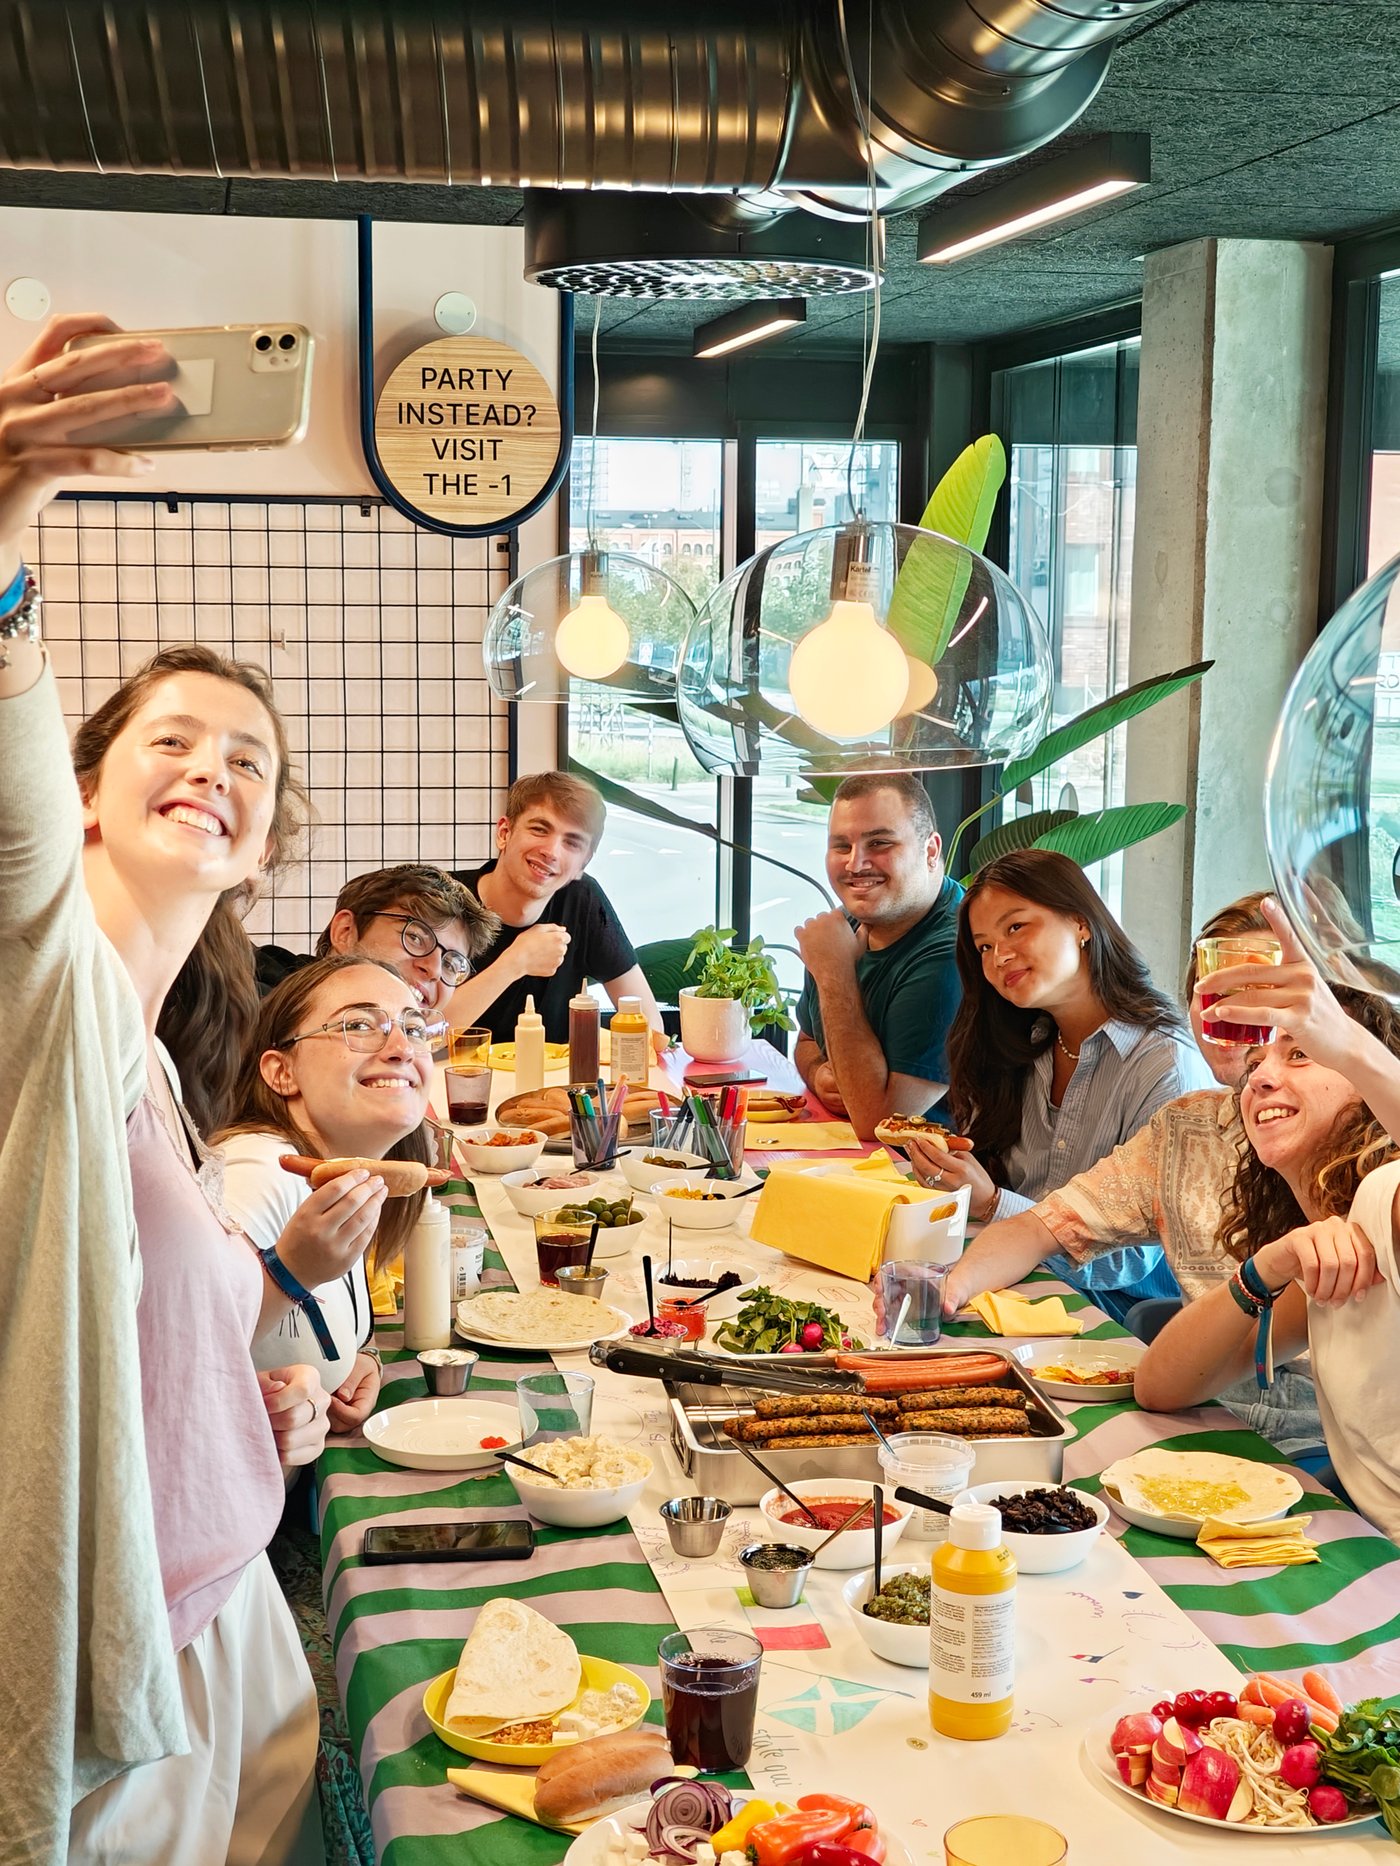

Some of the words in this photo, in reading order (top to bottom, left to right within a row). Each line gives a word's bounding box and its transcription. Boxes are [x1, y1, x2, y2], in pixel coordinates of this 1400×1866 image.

[421, 367, 513, 391] PARTY
[398, 402, 537, 426] INSTEAD?
[431, 438, 504, 461] VISIT
[423, 473, 478, 496] THE
[488, 474, 511, 496] -1
[752, 1765, 802, 1788] qui
